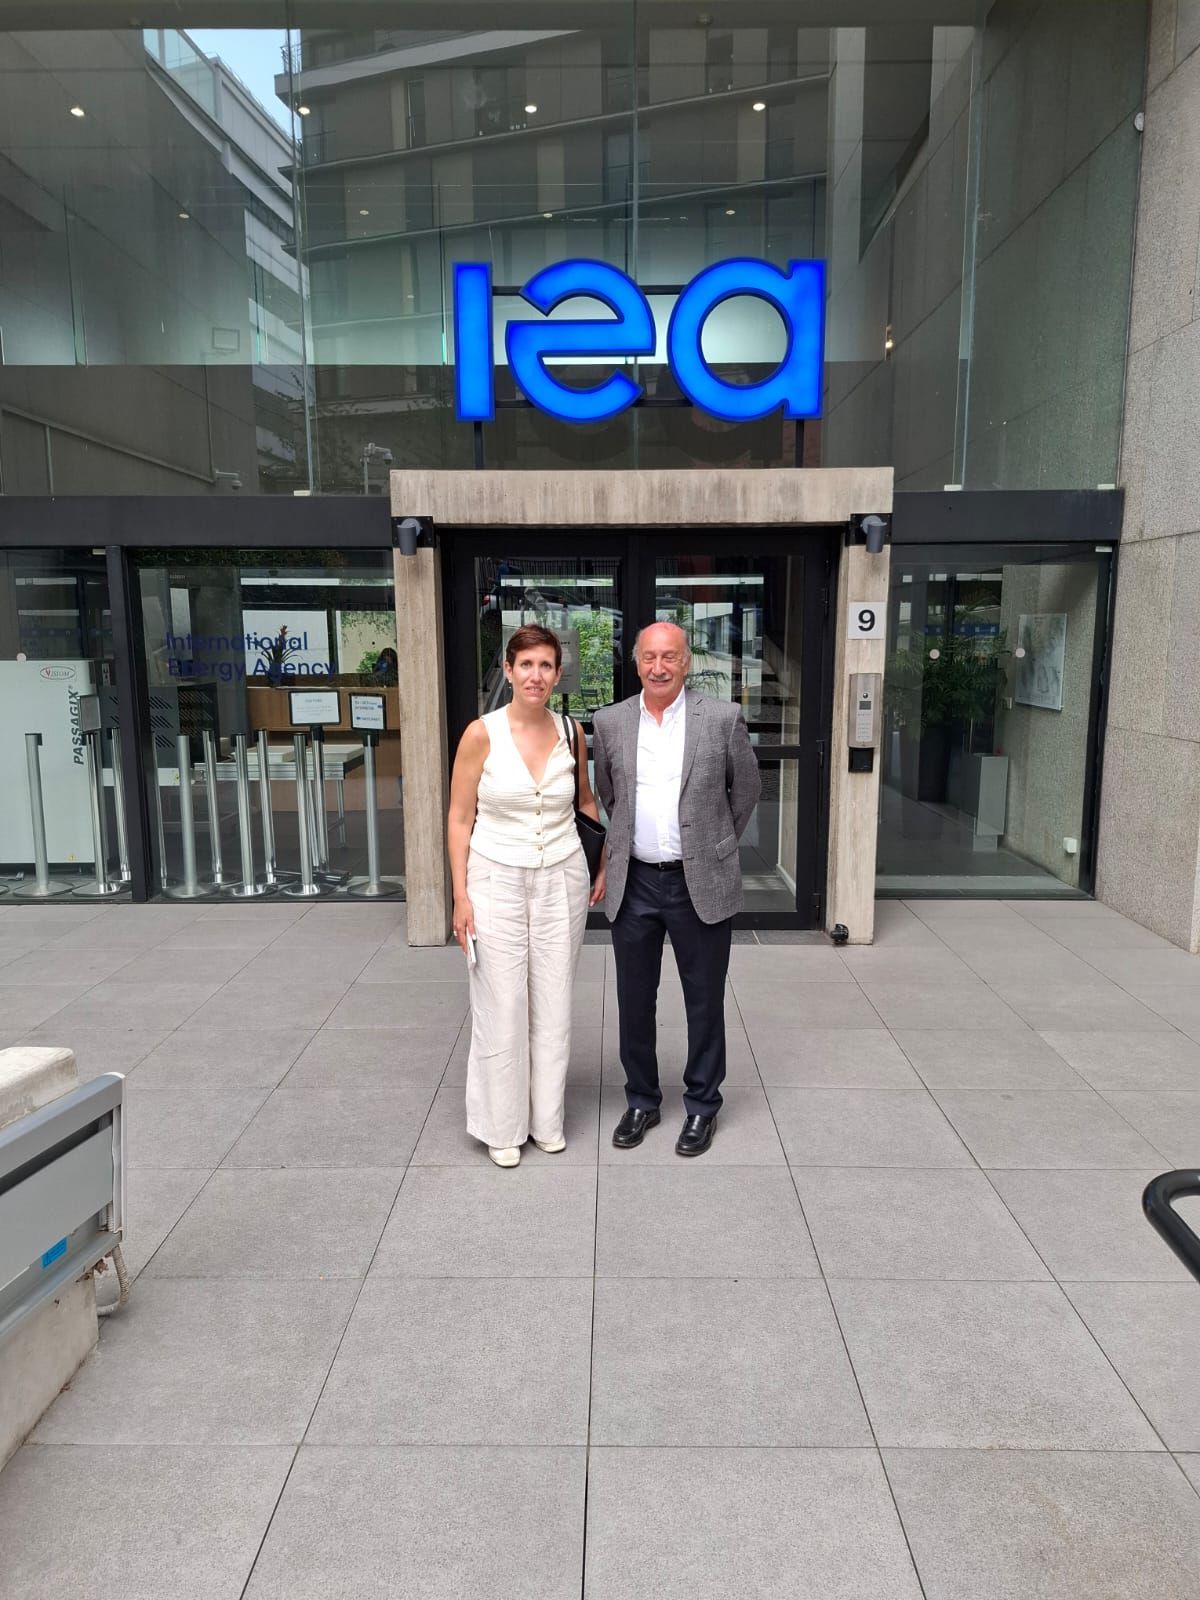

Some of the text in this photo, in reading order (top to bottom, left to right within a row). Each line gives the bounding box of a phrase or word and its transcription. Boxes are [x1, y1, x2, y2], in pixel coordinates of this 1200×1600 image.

[857, 609, 876, 632] 9
[166, 631, 307, 650] International
[168, 658, 245, 681] Eergy
